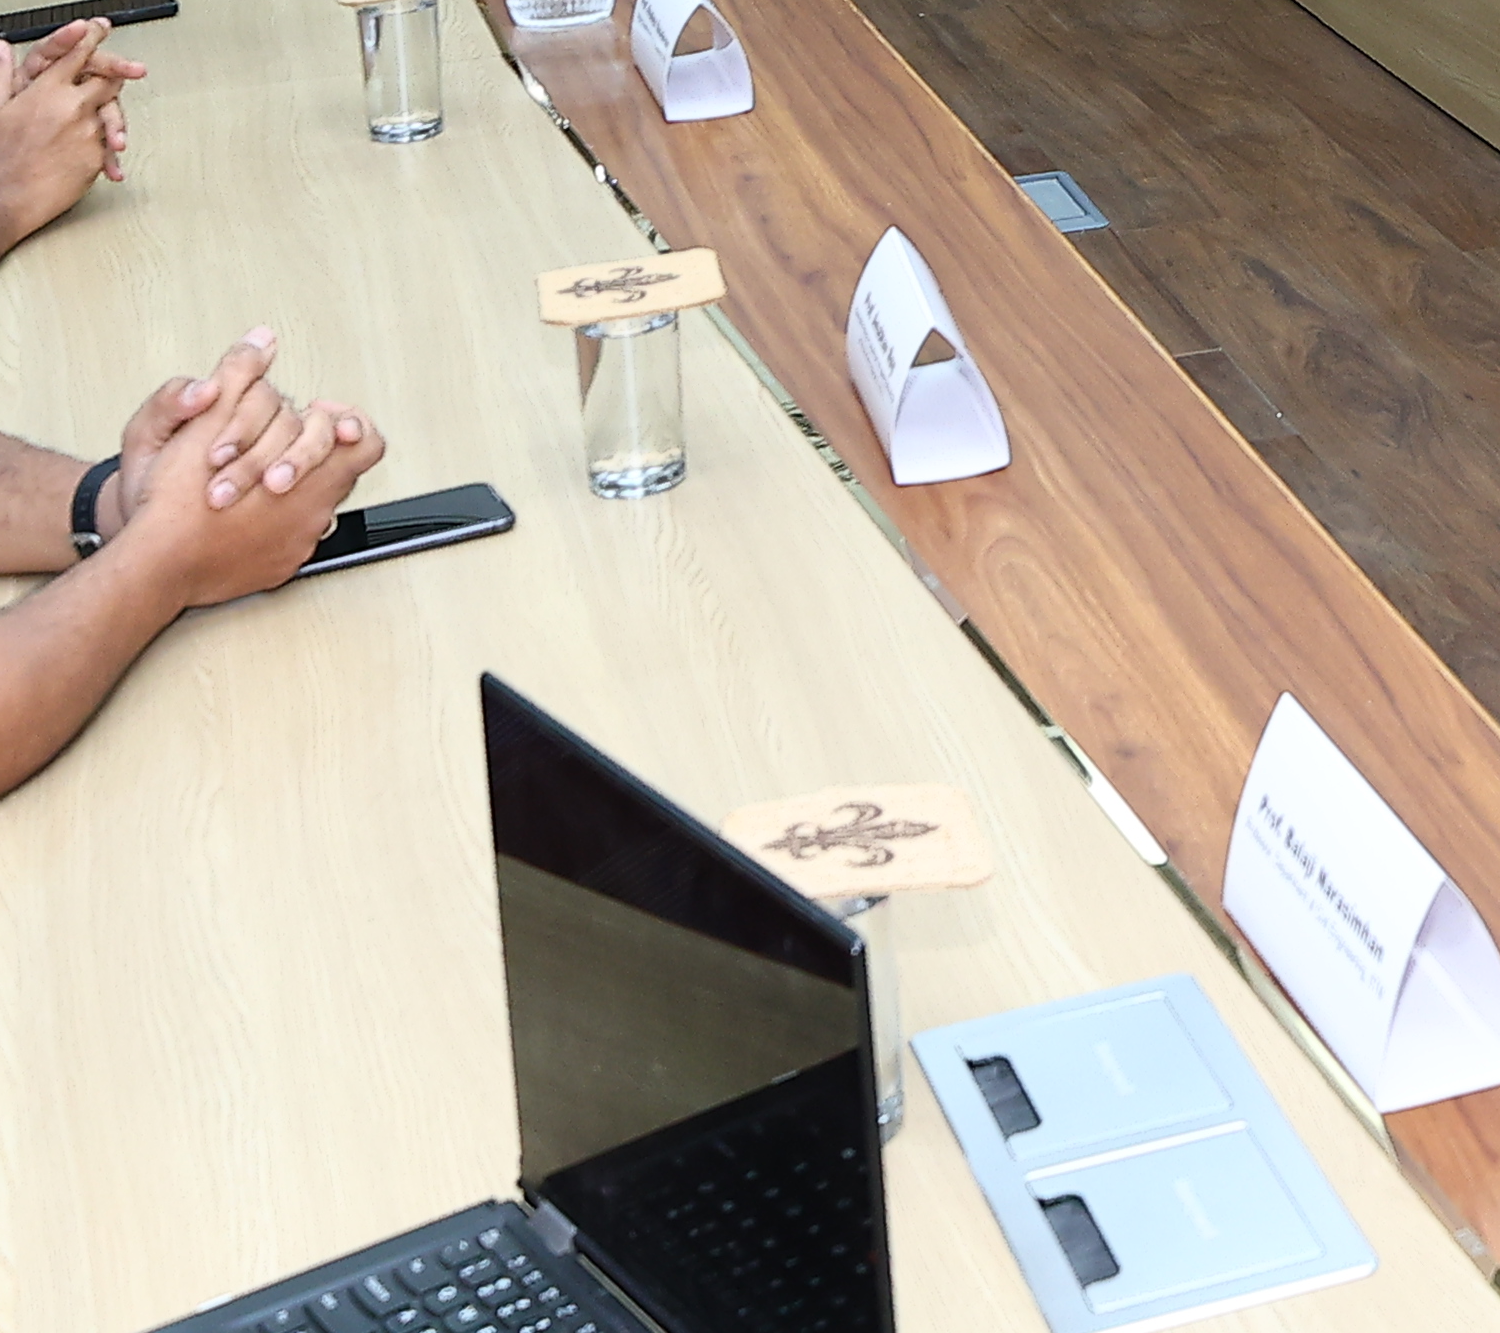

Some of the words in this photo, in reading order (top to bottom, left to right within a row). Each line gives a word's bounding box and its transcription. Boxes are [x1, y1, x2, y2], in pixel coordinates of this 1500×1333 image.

[1257, 793, 1285, 836] Prof.
[1284, 824, 1316, 878] Balaji
[1317, 863, 1386, 962] Narasimhan
